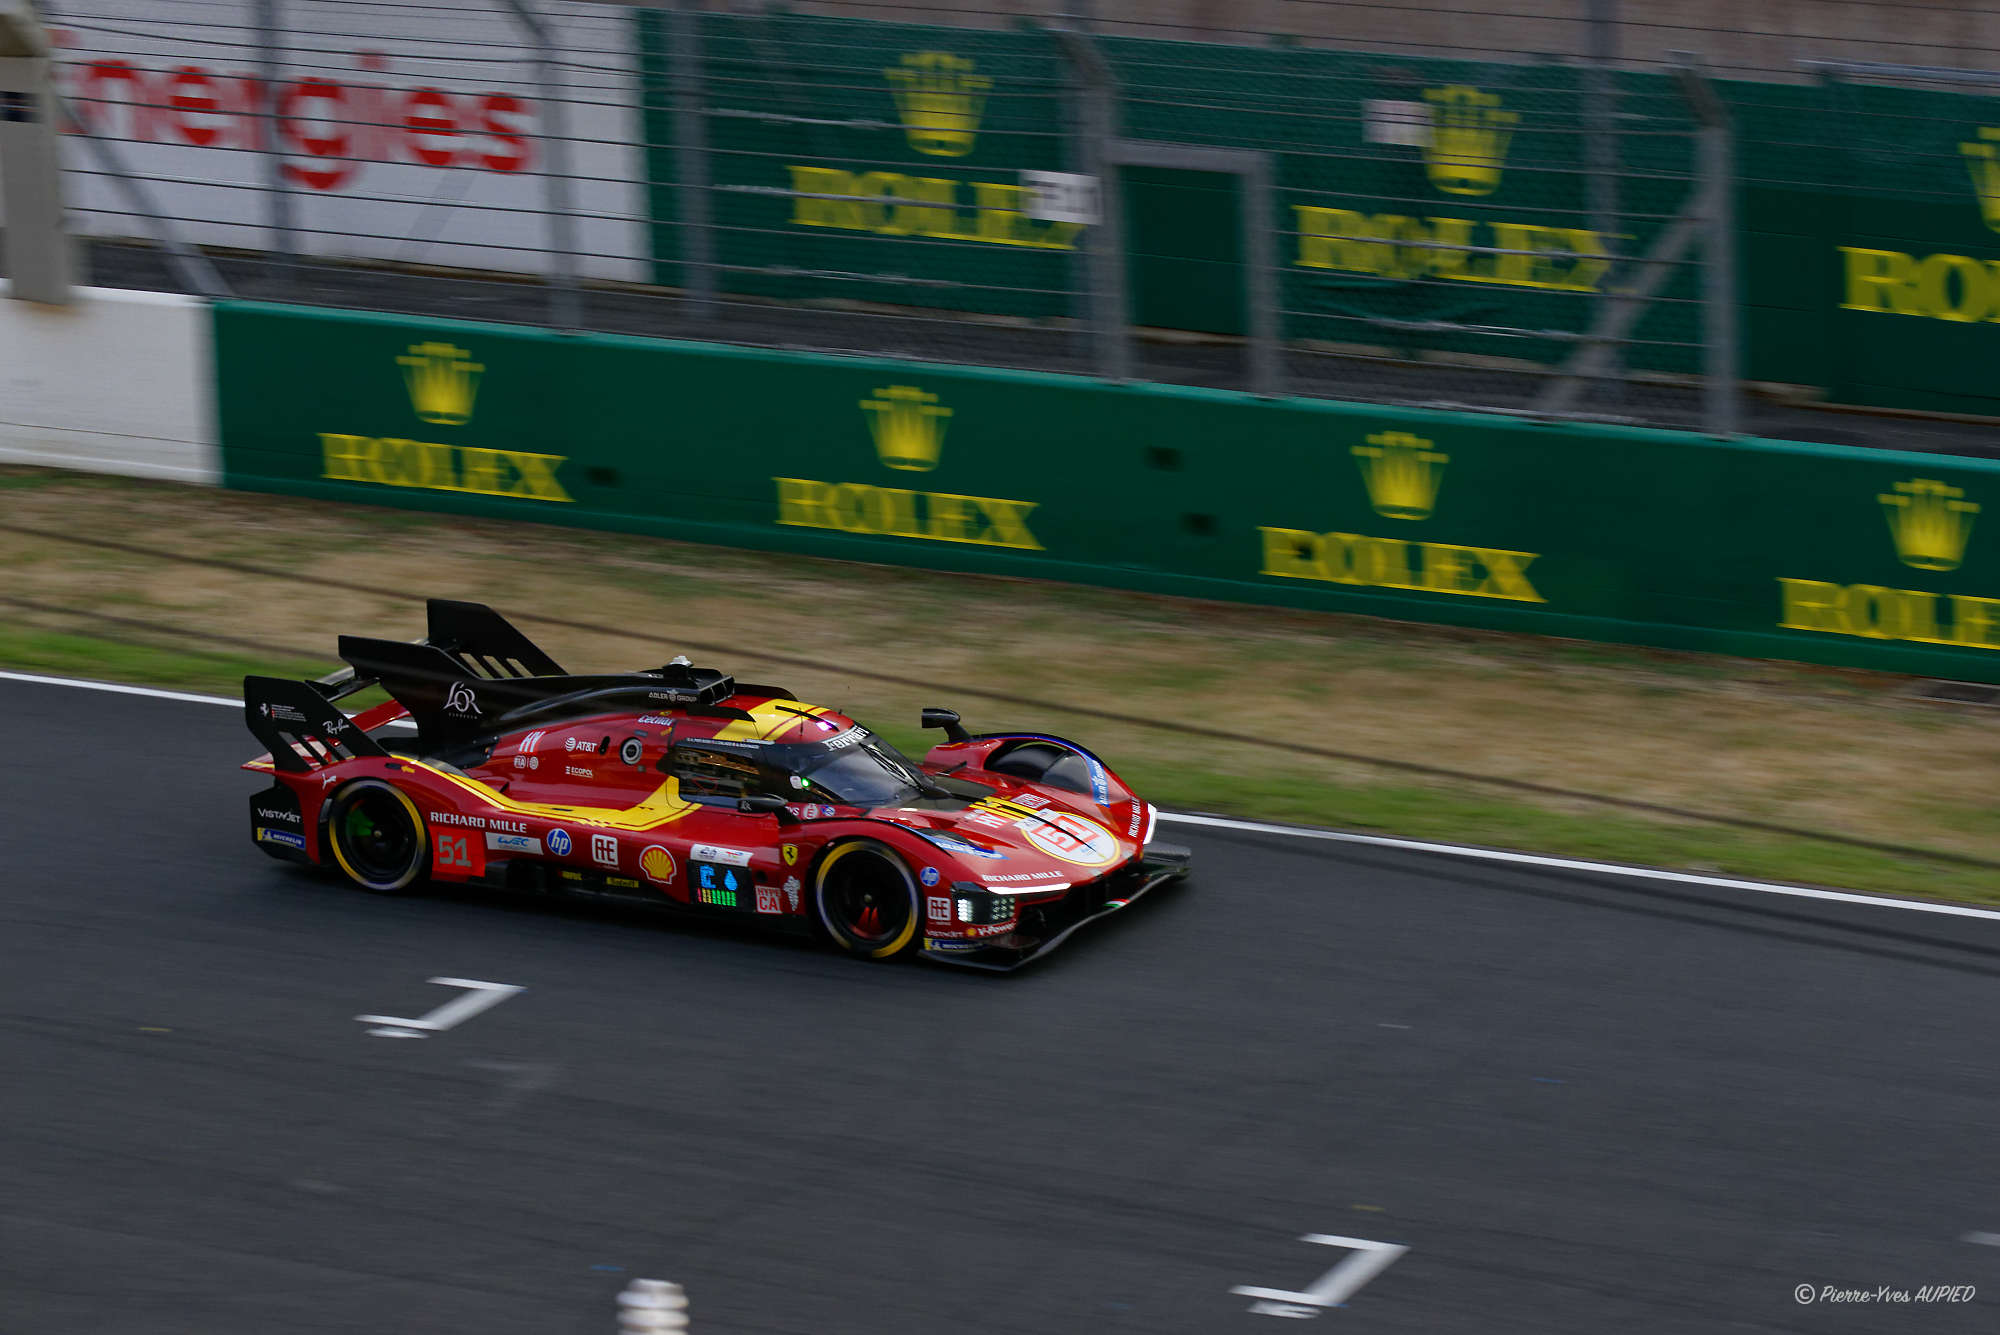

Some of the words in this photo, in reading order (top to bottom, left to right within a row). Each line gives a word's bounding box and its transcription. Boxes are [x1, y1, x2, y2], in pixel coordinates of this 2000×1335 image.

[317, 432, 575, 502] ROLEX
[772, 476, 1046, 551] ROLEX
[1257, 525, 1548, 603] ROLEX
[575, 740, 598, 753] AT&T
[430, 811, 486, 828] RICHARD
[489, 818, 528, 833] MILLE
[438, 834, 472, 868] 51
[551, 830, 569, 855] hp
[982, 873, 1032, 882] RICHARD
[1030, 870, 1065, 880] MILLE
